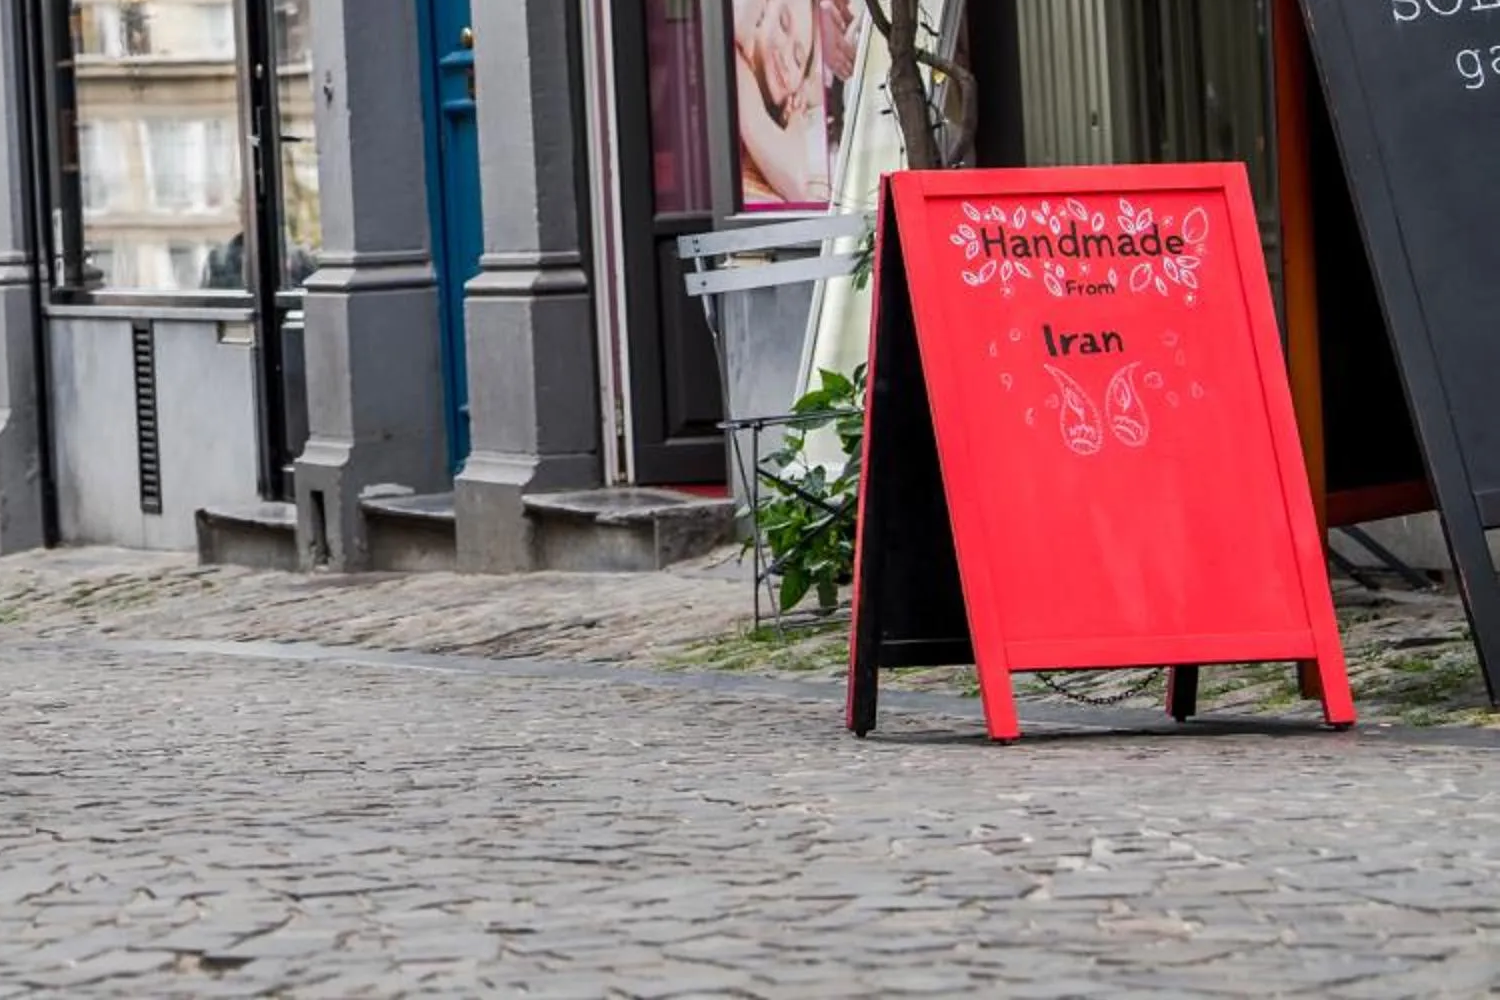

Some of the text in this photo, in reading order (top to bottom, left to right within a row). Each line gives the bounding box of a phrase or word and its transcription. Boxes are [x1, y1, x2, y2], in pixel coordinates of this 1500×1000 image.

[980, 220, 1185, 259] Handmade
[1065, 279, 1116, 296] From
[1043, 323, 1124, 357] Iran
